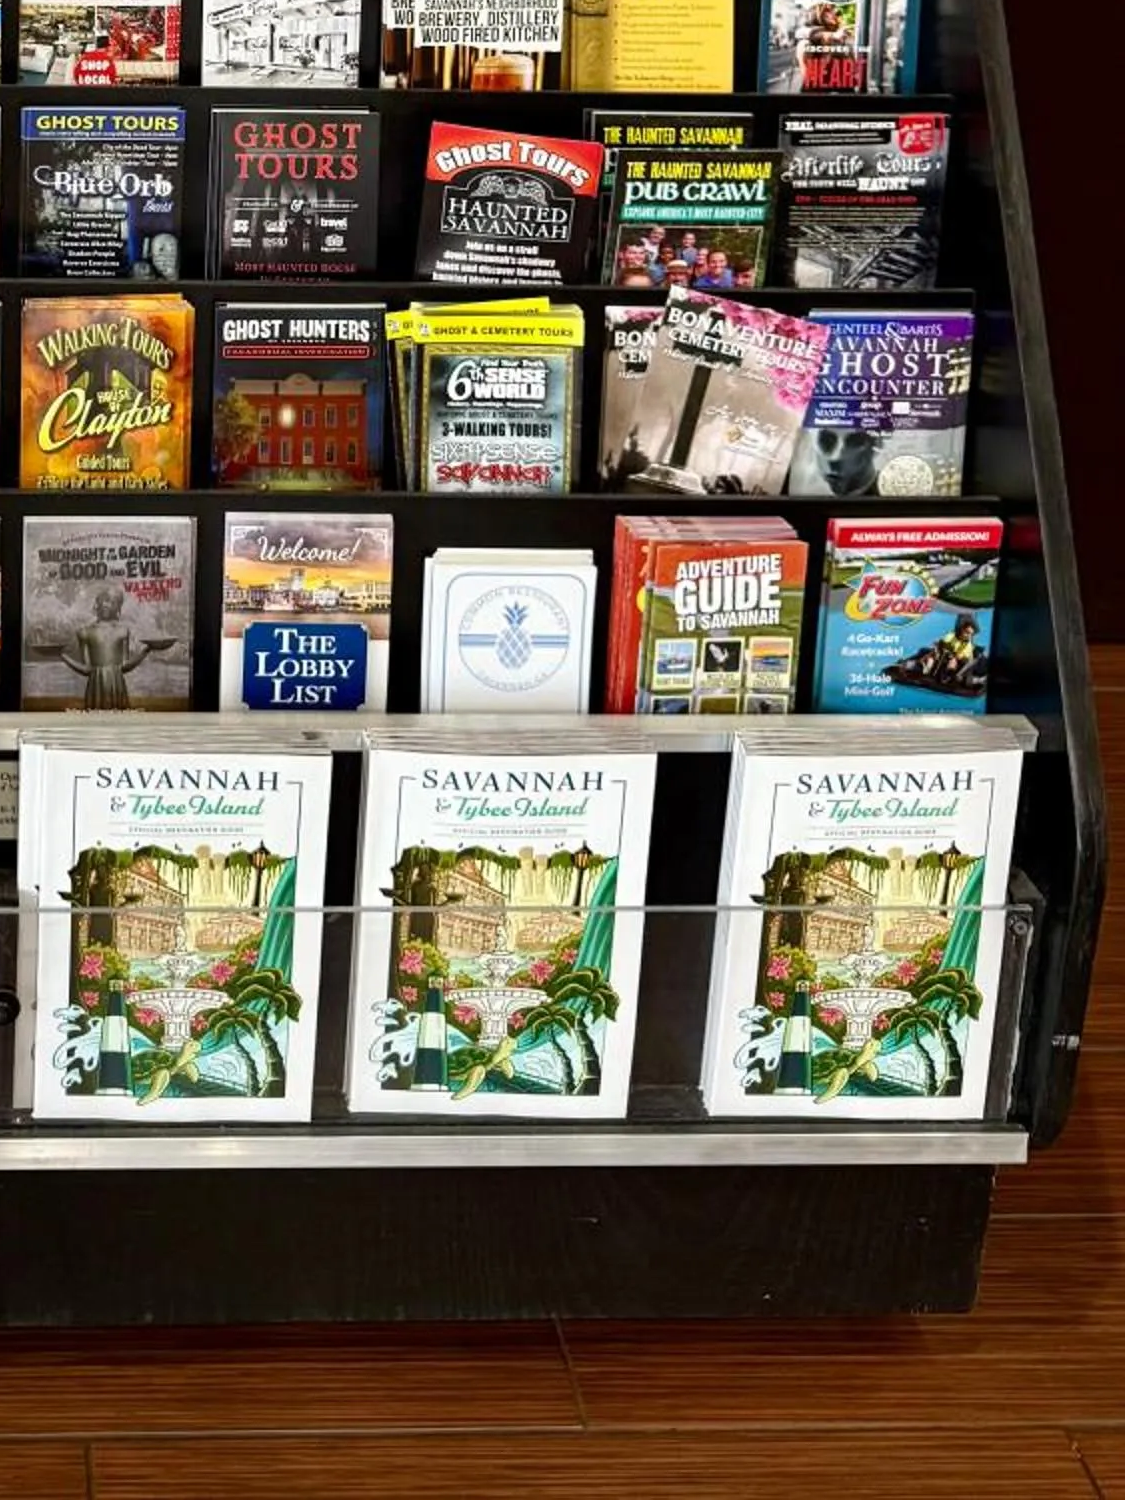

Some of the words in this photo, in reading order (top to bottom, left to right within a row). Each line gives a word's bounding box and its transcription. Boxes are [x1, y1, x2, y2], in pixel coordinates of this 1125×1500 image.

[422, 27, 458, 43] WOOD
[463, 27, 499, 42] FIRED
[503, 25, 558, 41] KITCHEN
[81, 60, 109, 71] SHOP
[79, 74, 110, 84] LOCAL
[37, 116, 110, 131] GHOST
[114, 116, 178, 130] TOURS
[235, 123, 361, 149] GHOST
[235, 155, 359, 180] TOURS
[435, 142, 514, 173] Ghost
[519, 143, 589, 187] Tours
[447, 198, 567, 223] HAUNTED
[445, 216, 567, 239] SAVANNAH
[224, 320, 283, 341] GHOST
[289, 319, 369, 341] HUNTERS
[433, 327, 468, 335] GHOST
[470, 327, 477, 335] &
[481, 327, 535, 337] CEMETERY
[539, 327, 573, 338] TOURS
[669, 308, 818, 359] BONAVENTURE
[38, 389, 172, 453] Clayton
[851, 533, 894, 541] ALWAYS
[897, 533, 922, 541] FREE
[925, 533, 989, 541] ADMISSION!
[259, 537, 359, 562] Welcome!
[676, 554, 781, 580] ADVENTURE
[676, 576, 781, 614] GUIDE
[676, 618, 697, 632] TO
[701, 610, 780, 628] SAVANNAH
[275, 628, 336, 654] THE
[255, 653, 354, 678] LOBBY
[271, 679, 336, 703] LIST
[97, 768, 280, 791] SAVANNAH
[423, 769, 603, 791] SAVANNAH
[797, 770, 973, 795] SAVANNAH
[110, 796, 125, 812] &
[128, 795, 186, 819] Tybee
[189, 796, 264, 816] Island
[809, 802, 824, 818] &
[826, 799, 882, 822] Tybee
[884, 798, 959, 818] Island
